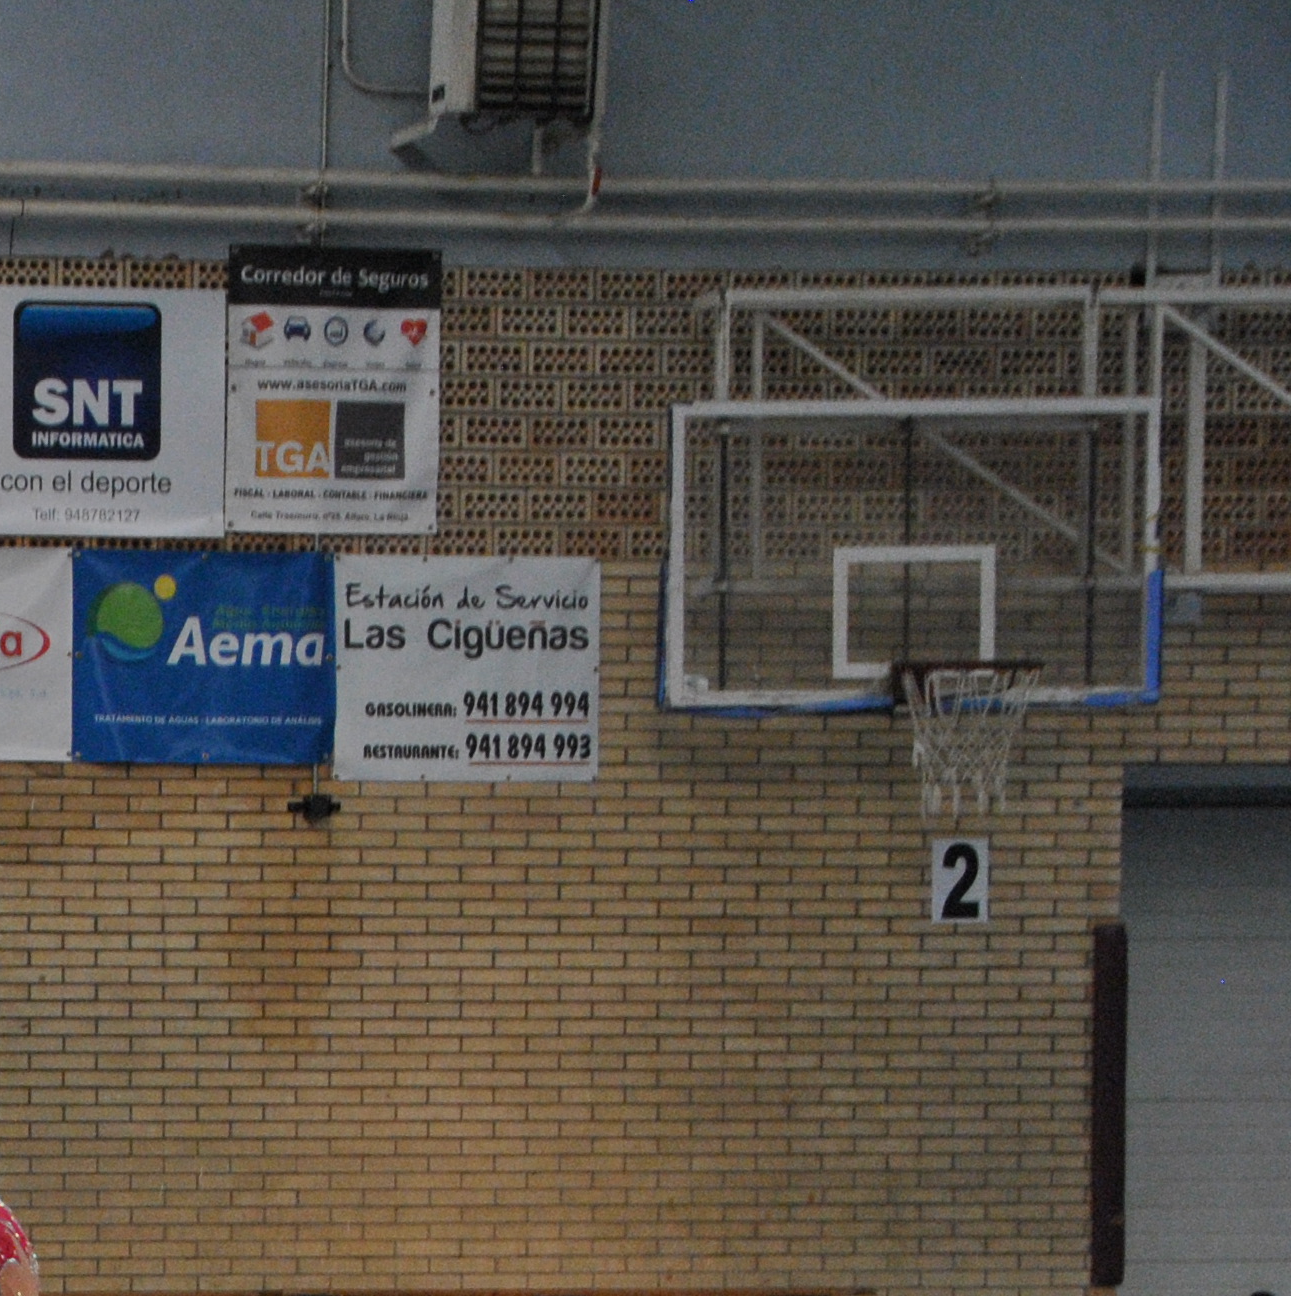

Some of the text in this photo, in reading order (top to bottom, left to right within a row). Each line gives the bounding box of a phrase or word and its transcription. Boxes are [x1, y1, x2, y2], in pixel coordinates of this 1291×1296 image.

[241, 264, 325, 284] Corredor
[331, 267, 352, 285] de
[359, 269, 429, 294] Seguros
[32, 378, 143, 427] SNT
[32, 431, 144, 449] INFORMATICA
[258, 440, 329, 473] TGA
[0, 470, 171, 498] con el deporte
[345, 582, 589, 610] Estación de Servicio
[166, 615, 325, 666] Aema
[344, 618, 590, 659] Las Cigüeñas
[365, 691, 590, 718] GASOLINERA: 941 894 994
[363, 732, 591, 760] RESTAURANTE: 941 894 993
[942, 843, 979, 918] 2
